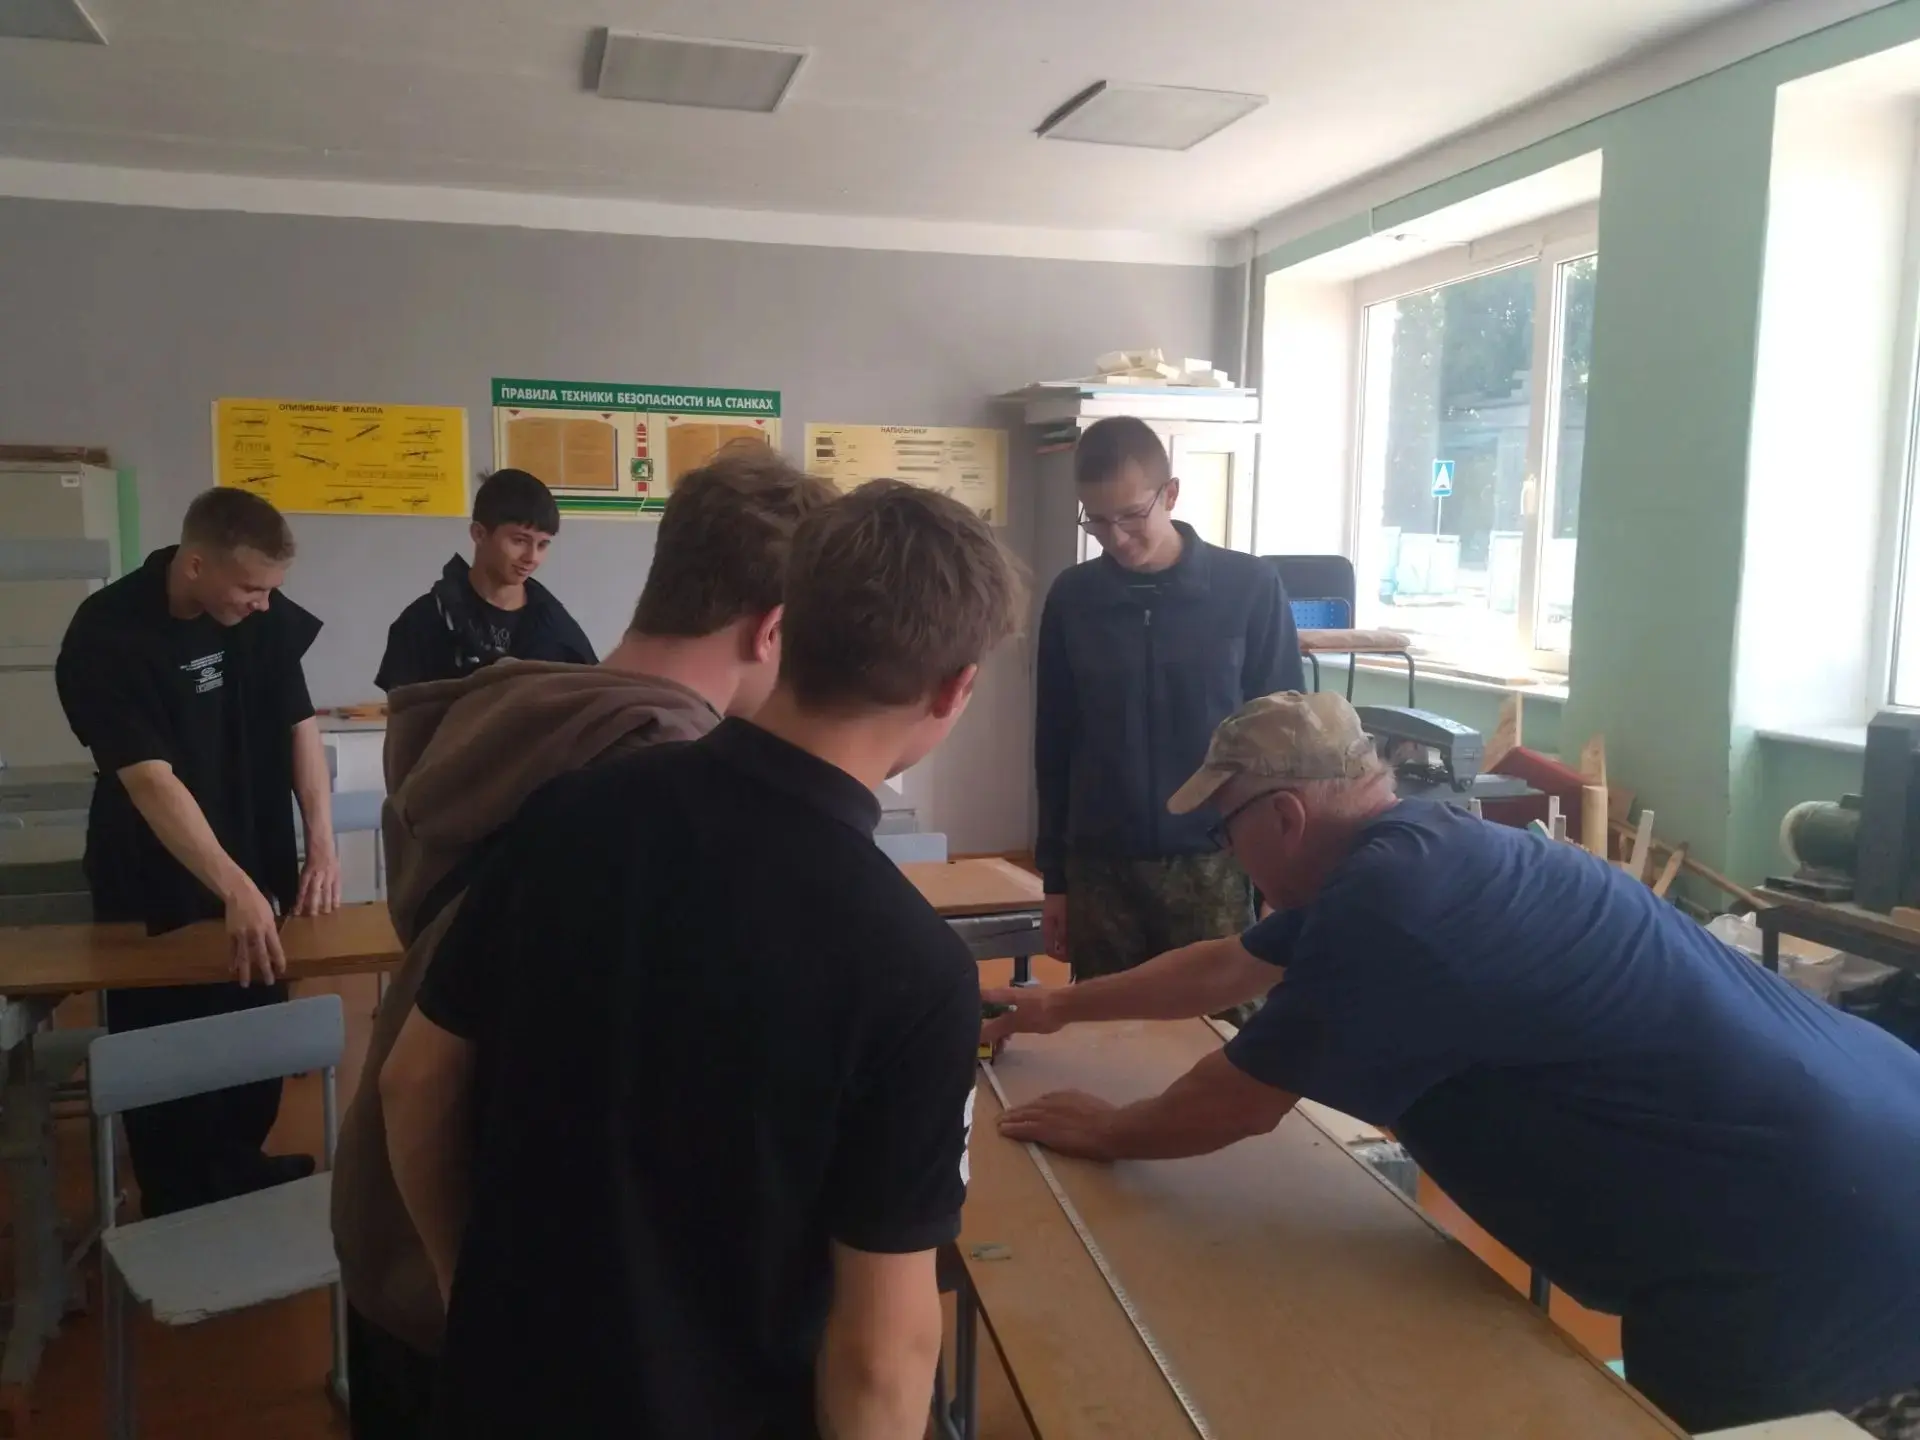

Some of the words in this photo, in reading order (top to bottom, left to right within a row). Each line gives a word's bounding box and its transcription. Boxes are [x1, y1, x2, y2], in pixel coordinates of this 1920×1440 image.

[501, 386, 558, 401] ПРАВИЛА
[561, 389, 613, 404] ТЕХНИКИ
[617, 392, 703, 407] БЕЗОПАСНОСТИ
[706, 395, 723, 408] НА
[725, 396, 774, 410] СТАНКАХ
[278, 403, 338, 413] ОПИЛИВАНИЕ
[342, 405, 384, 414] МЕТАЛЛА
